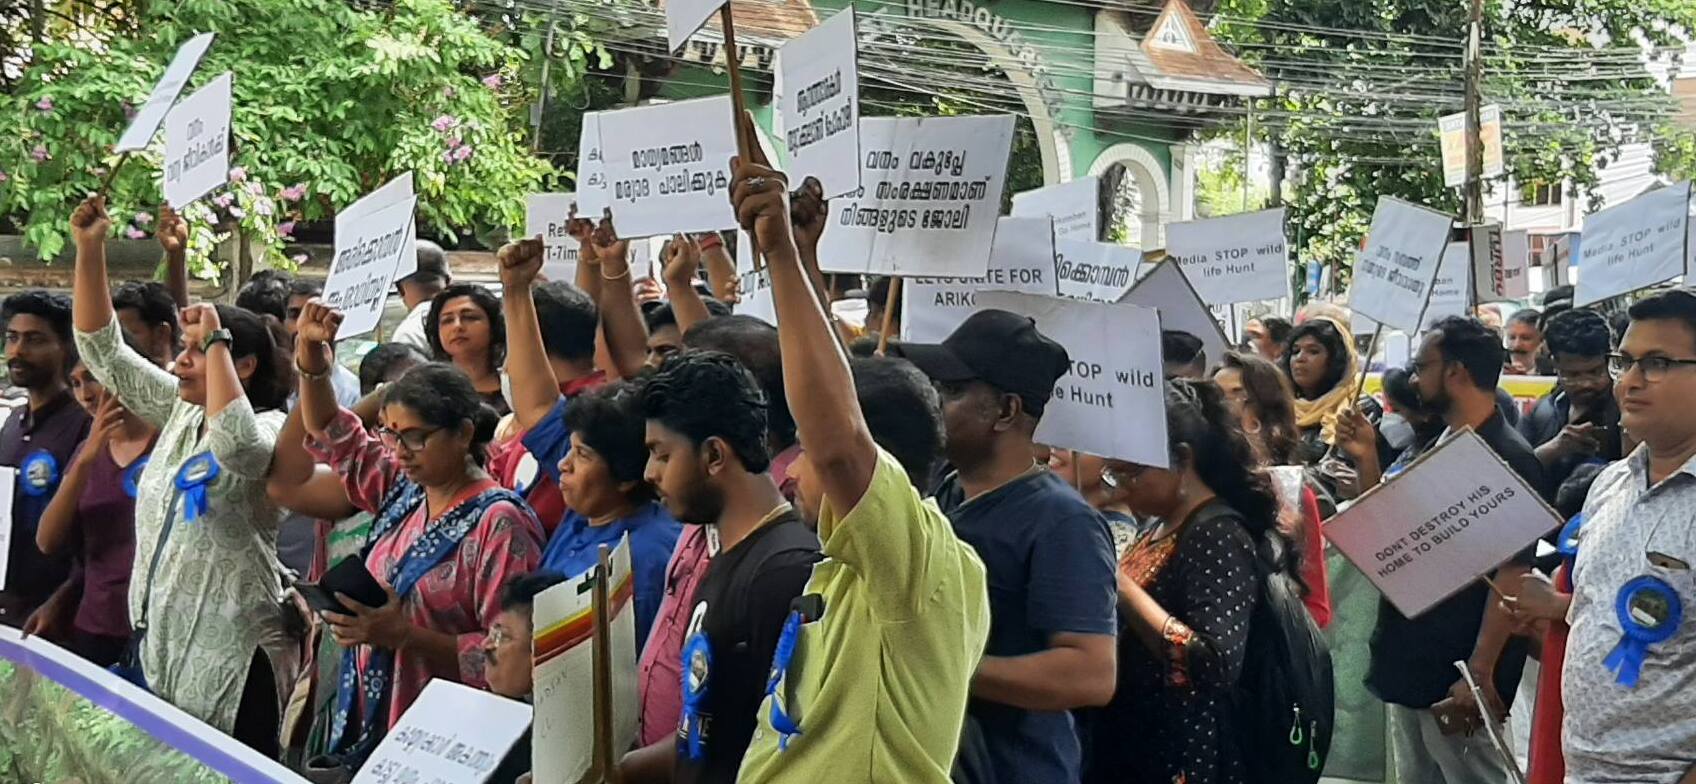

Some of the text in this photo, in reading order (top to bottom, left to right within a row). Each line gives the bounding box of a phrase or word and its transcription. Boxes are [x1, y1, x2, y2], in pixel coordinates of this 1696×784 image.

[866, 151, 899, 170] വനം
[659, 168, 727, 196] പാലിക്കുക
[876, 175, 991, 200] സംരക്ഷണമാണ്
[840, 202, 970, 234] നിങ്ങളുടെ ജോലി
[1620, 227, 1652, 248] STOP
[1657, 217, 1681, 234] wild
[1215, 247, 1249, 262] STOP
[1256, 243, 1283, 256] wild
[1607, 243, 1654, 267] life Hunt
[1009, 268, 1042, 284] FOR
[1203, 262, 1255, 278] life Hunt
[934, 291, 976, 307] ARIK
[1068, 360, 1154, 388] TOP wild
[1070, 385, 1113, 408] Hunt
[1375, 485, 1491, 562] DONT DESTROY HIS
[1377, 487, 1516, 578] HOME TO BUILD YOURS
